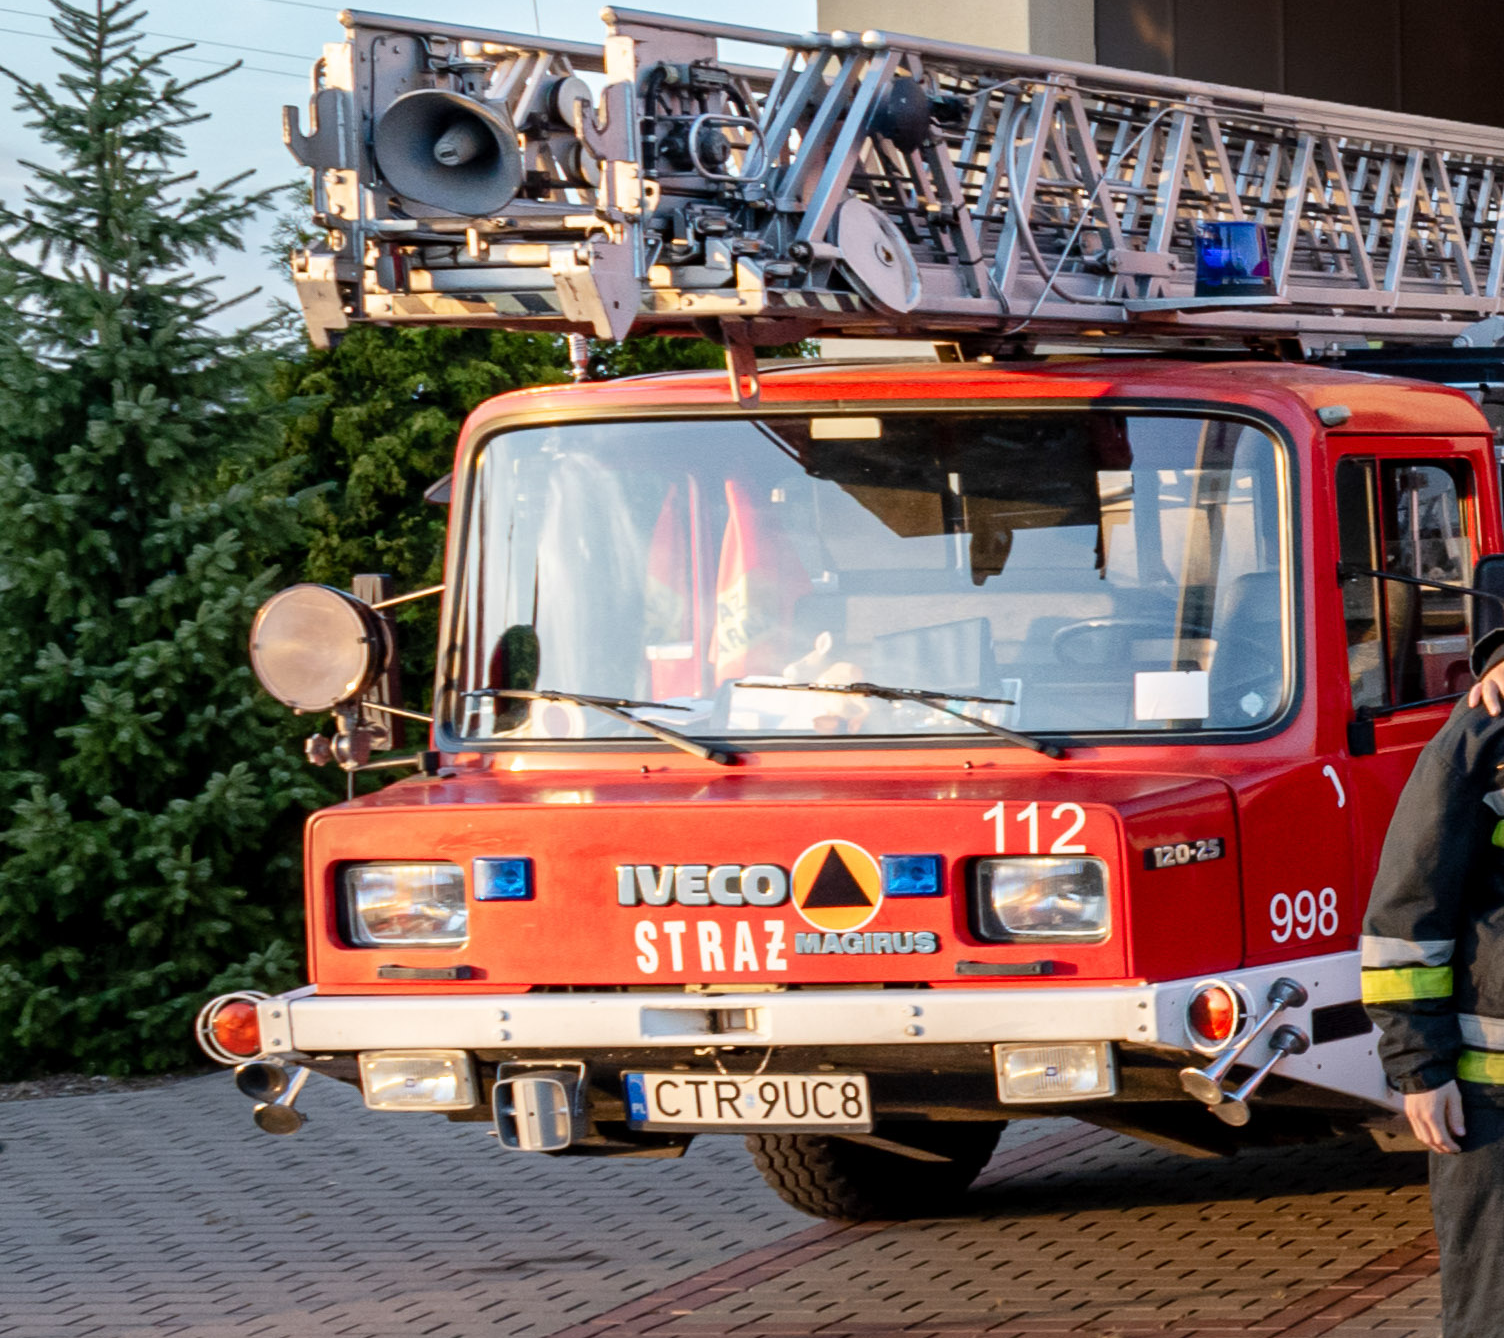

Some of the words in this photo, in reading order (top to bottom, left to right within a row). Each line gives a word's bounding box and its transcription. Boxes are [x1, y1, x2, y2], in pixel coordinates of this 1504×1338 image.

[982, 801, 1087, 854] 112
[1153, 839, 1221, 868] 120-25
[617, 863, 790, 907] IVECO
[1269, 887, 1339, 943] 998
[636, 919, 789, 974] STRAŻ
[795, 932, 938, 956] MAGIRUS
[631, 1102, 646, 1114] PL
[654, 1079, 741, 1120] CTR
[761, 1077, 864, 1119] 9UC8
